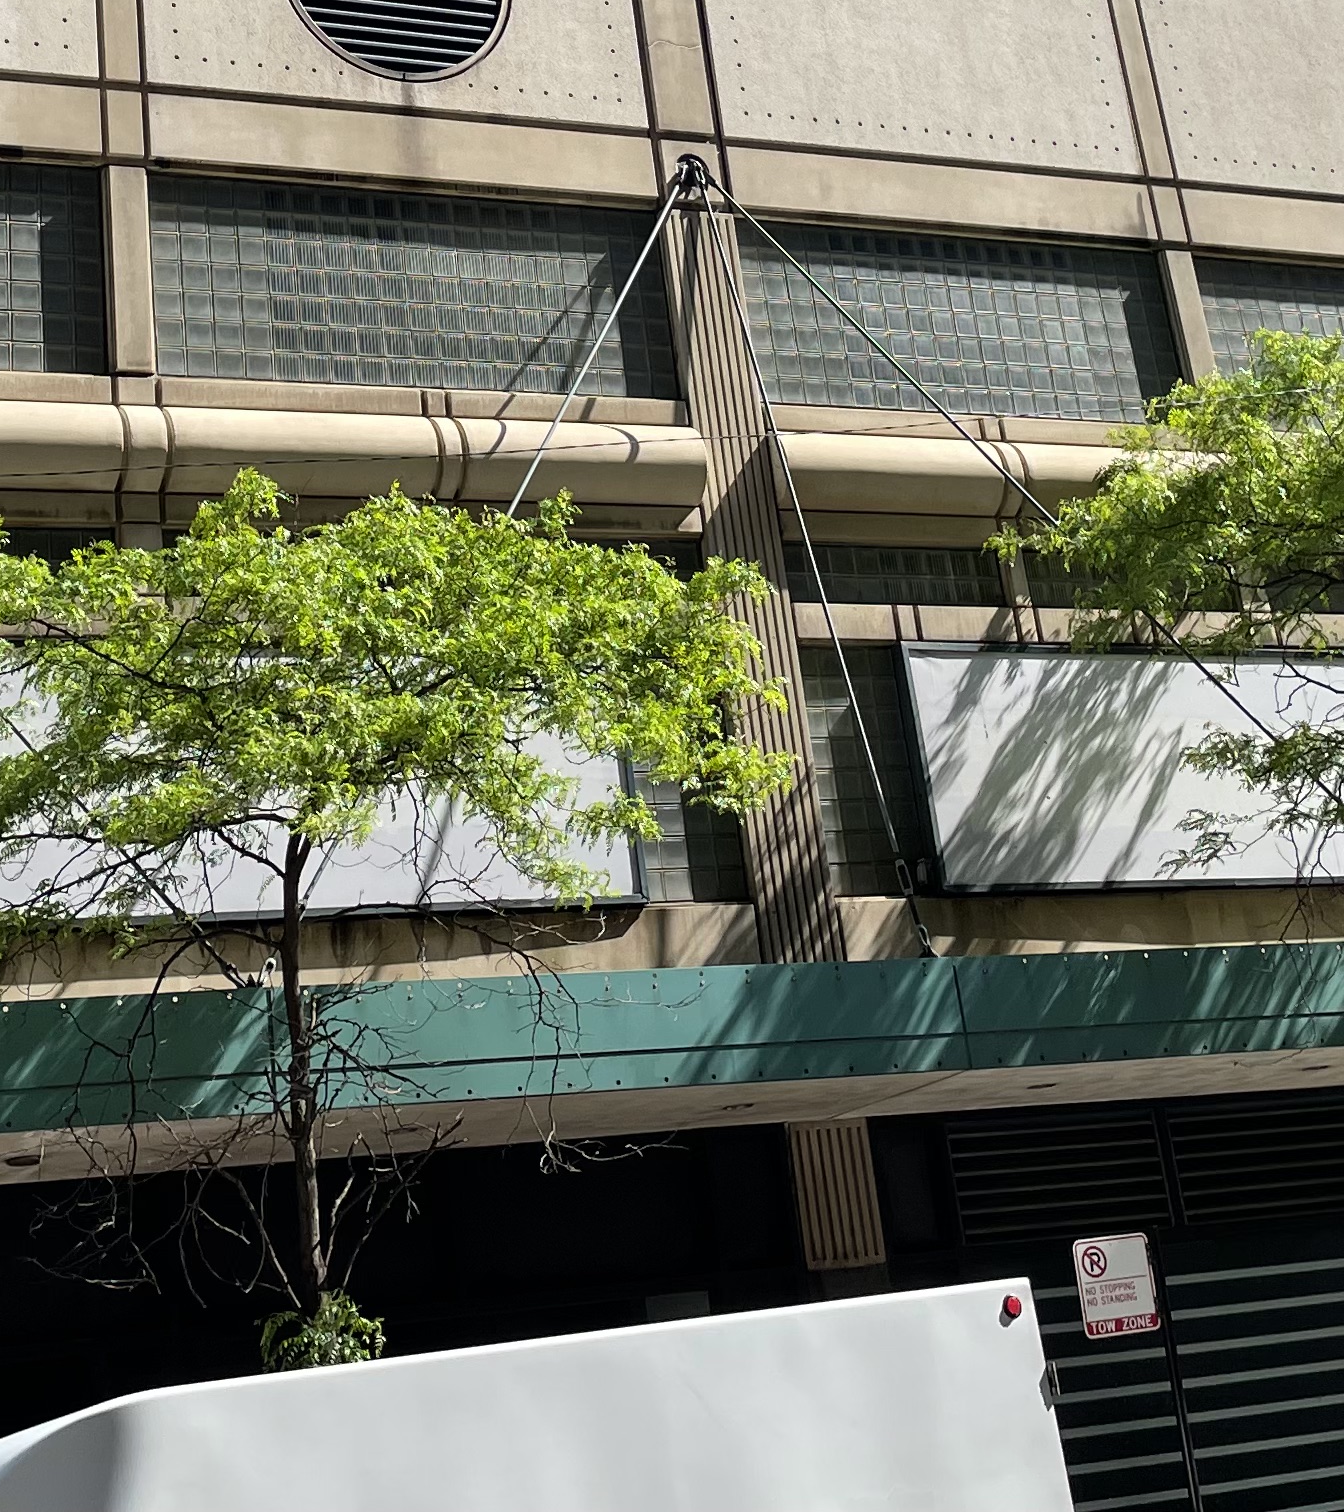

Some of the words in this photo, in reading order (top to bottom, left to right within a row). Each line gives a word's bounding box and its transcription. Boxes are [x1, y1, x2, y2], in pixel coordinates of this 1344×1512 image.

[1085, 1286, 1096, 1296] NO
[1099, 1280, 1136, 1295] STOPPING
[1087, 1296, 1098, 1307] NO
[1101, 1291, 1137, 1305] STANDING
[1090, 1320, 1116, 1335] TOW
[1121, 1314, 1154, 1331] ZONE
